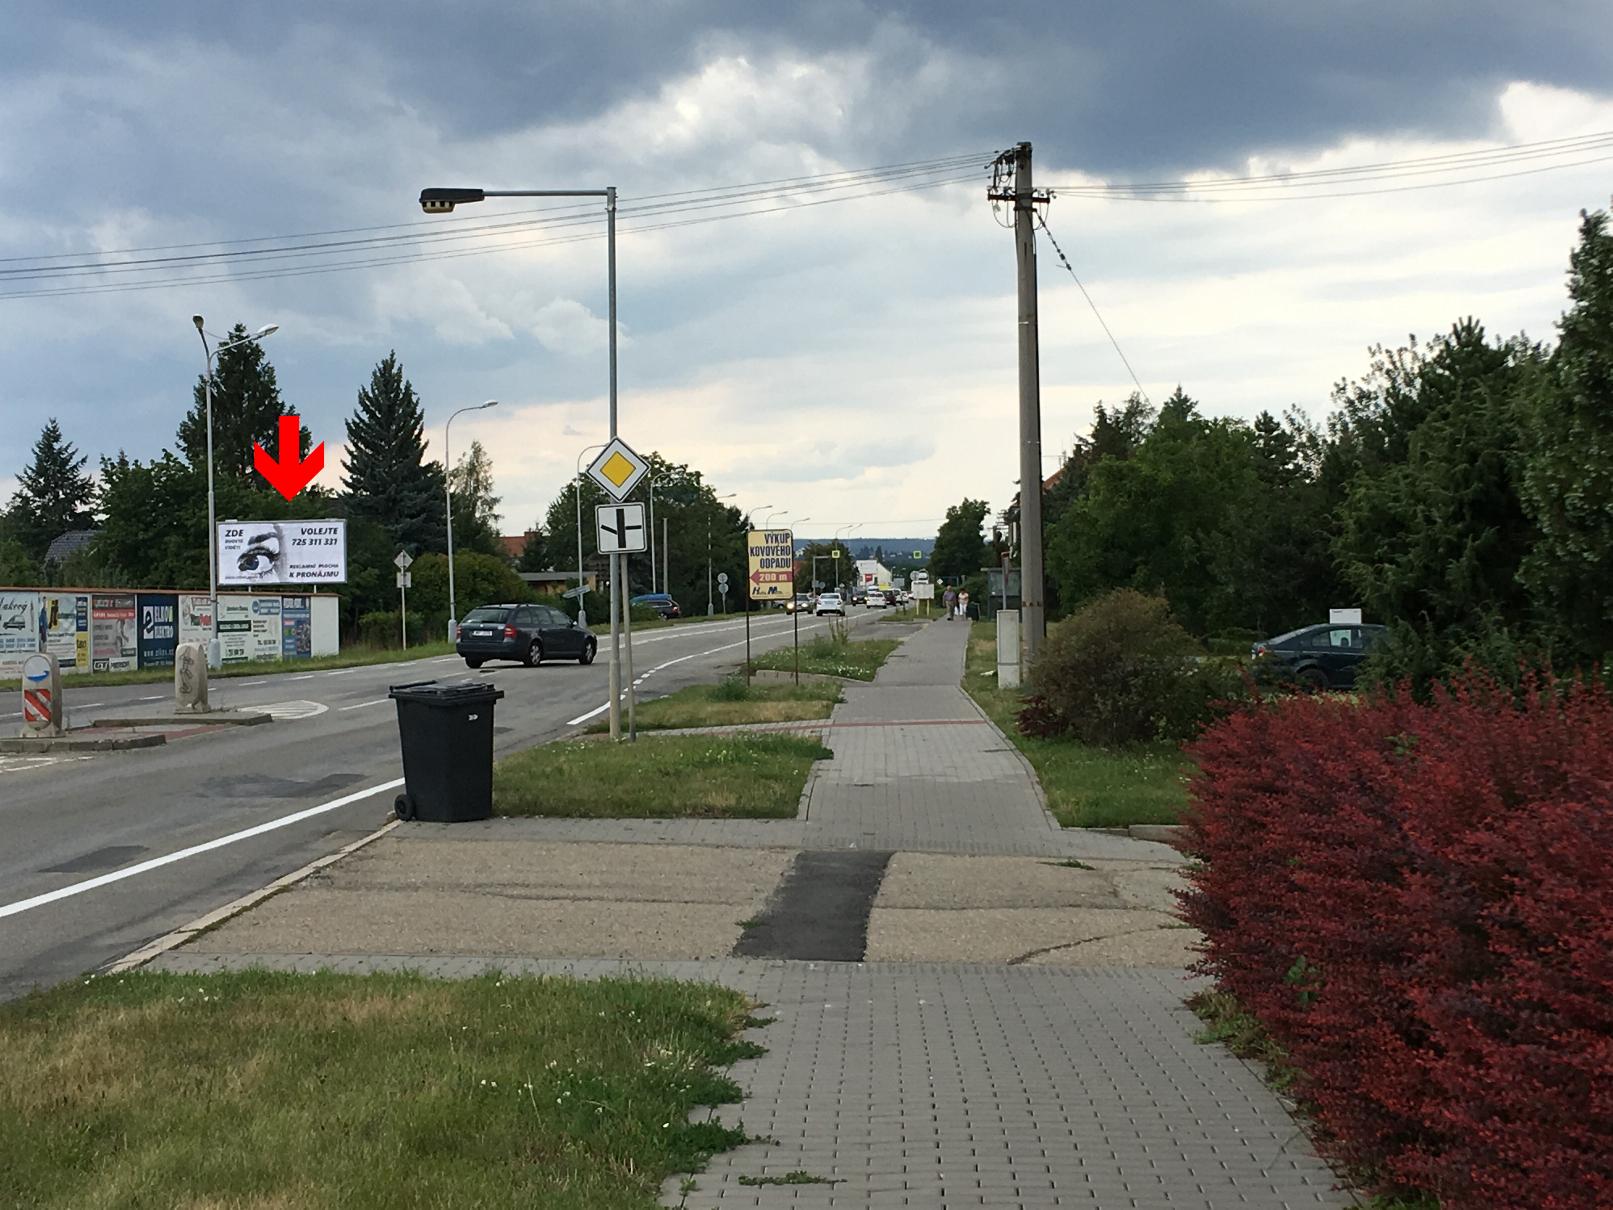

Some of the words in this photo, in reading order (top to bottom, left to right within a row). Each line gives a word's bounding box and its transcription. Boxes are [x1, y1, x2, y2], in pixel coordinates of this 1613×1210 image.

[225, 529, 244, 537] ZDE
[301, 527, 339, 535] VOLEJTE
[764, 531, 791, 544] VÝKUP
[291, 538, 307, 546] 725
[308, 538, 322, 546] 311
[749, 544, 791, 557] KOVOVÉHO
[760, 558, 791, 569] ODPADU
[296, 570, 340, 578] PRONÁJMU
[760, 573, 777, 581] 200
